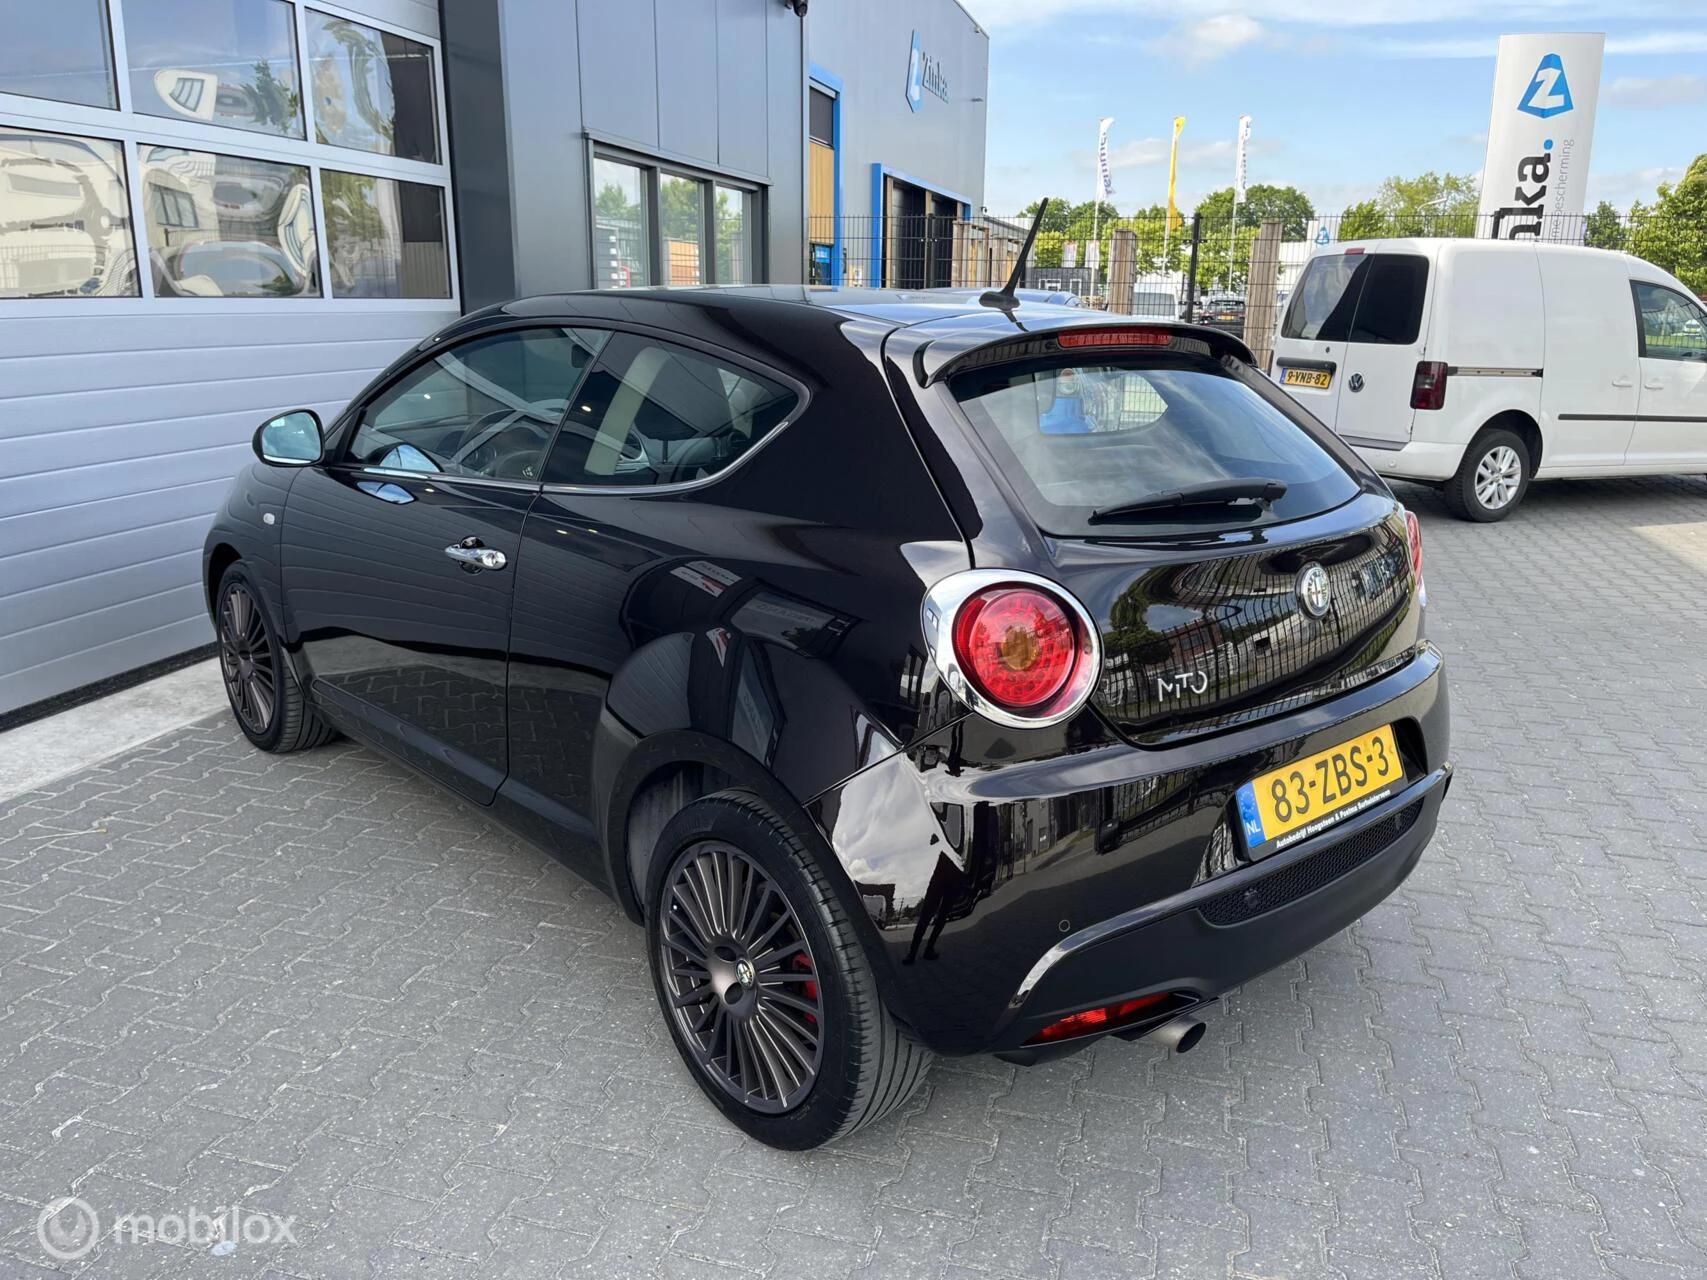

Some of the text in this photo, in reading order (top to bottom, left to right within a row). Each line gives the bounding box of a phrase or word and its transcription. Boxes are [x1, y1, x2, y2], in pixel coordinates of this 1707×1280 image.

[1287, 371, 1328, 386] 9-VNB-82
[1271, 736, 1389, 823] 83-ZBS-3
[1246, 820, 1261, 836] NL
[1276, 827, 1307, 848] Autobedrijf
